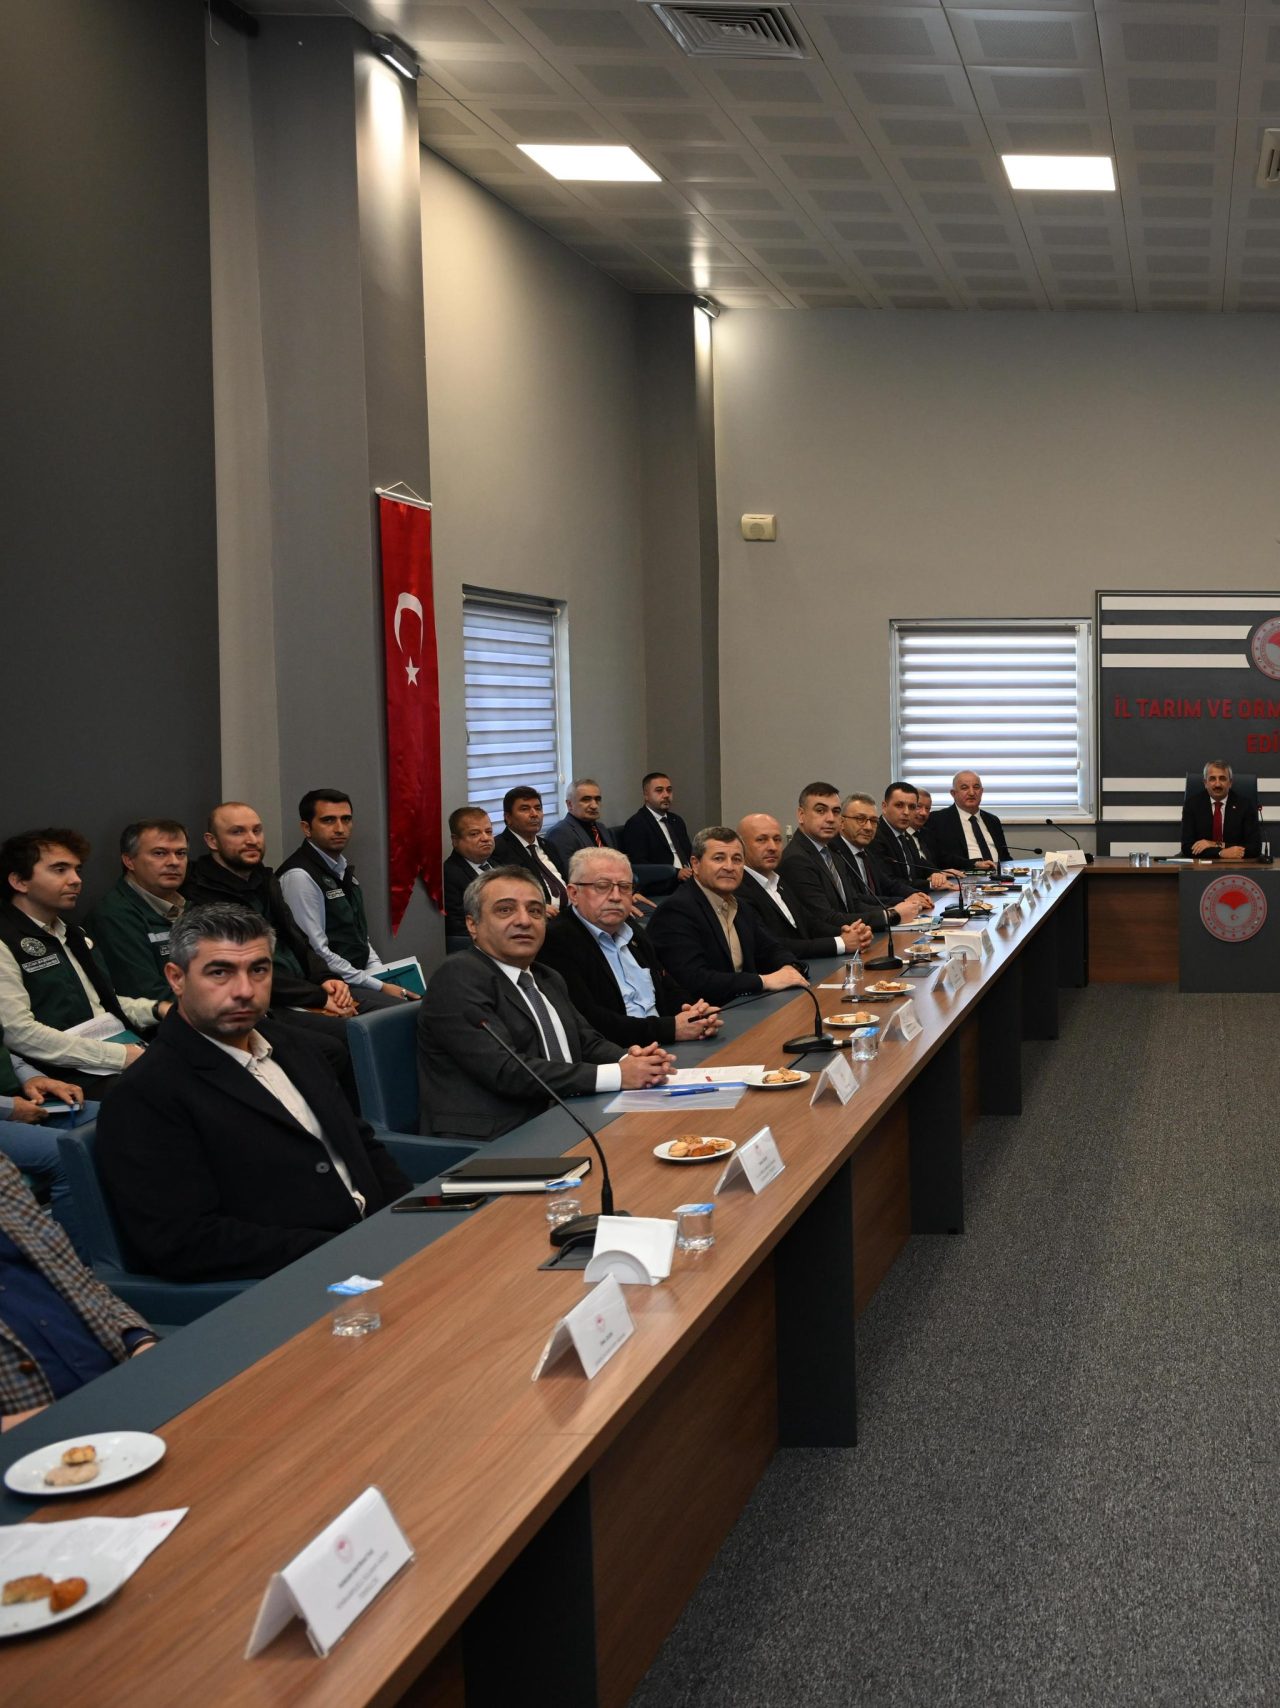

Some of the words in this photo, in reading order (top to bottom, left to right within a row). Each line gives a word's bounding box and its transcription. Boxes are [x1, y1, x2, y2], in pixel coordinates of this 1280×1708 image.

[1114, 694, 1132, 719] İL
[1136, 697, 1202, 719] TARIM
[1207, 697, 1233, 719] VE
